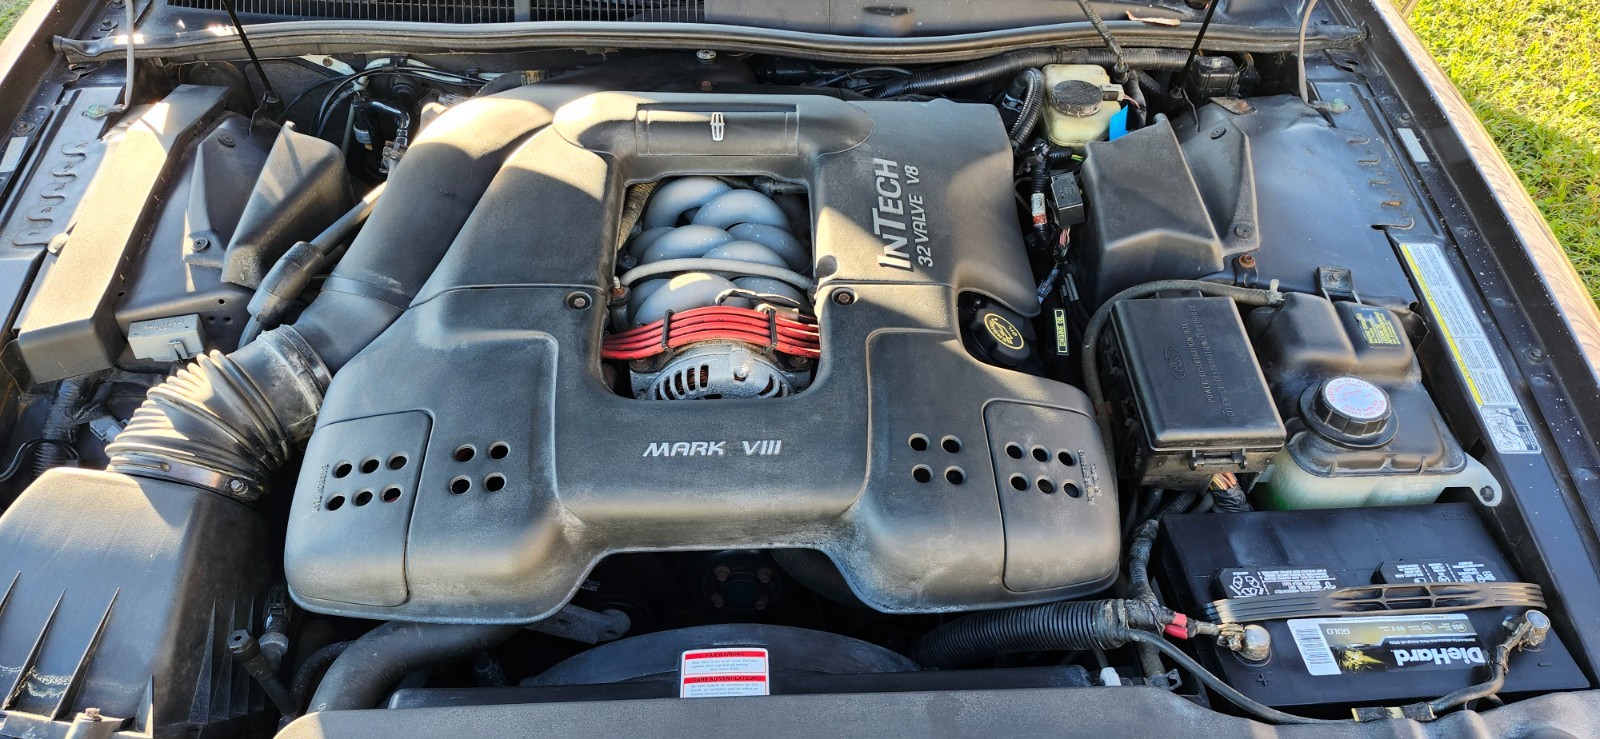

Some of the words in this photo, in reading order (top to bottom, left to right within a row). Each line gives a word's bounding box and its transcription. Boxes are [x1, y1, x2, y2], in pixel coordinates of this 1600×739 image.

[904, 164, 920, 185] V8
[908, 193, 929, 243] VALVE
[916, 245, 934, 267] 32
[1057, 325, 1067, 347] ENGINE
[642, 441, 727, 457] MARK
[742, 439, 782, 456] VIII
[1394, 647, 1486, 665] DieHard
